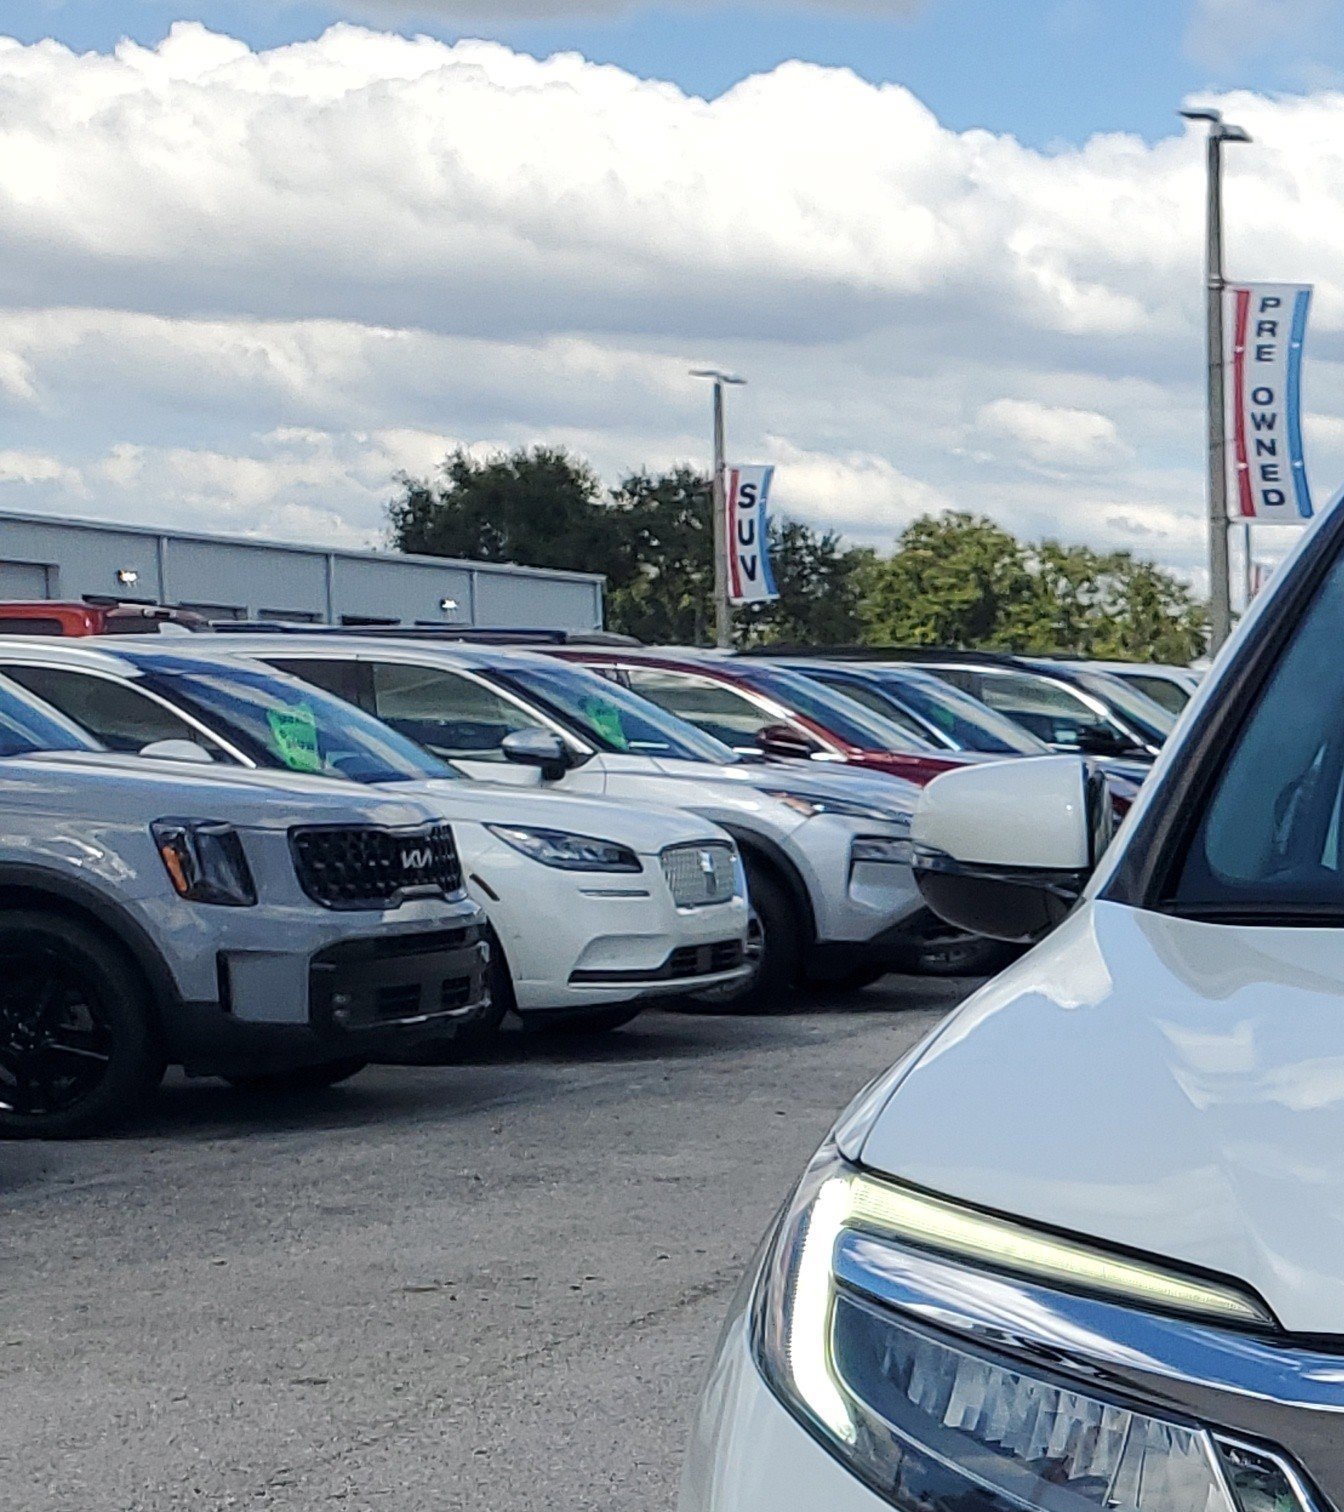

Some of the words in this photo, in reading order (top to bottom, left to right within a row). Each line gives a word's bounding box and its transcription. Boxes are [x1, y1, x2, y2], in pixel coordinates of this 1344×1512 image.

[1255, 296, 1281, 362] PRE
[1250, 386, 1286, 507] OWNED
[738, 483, 757, 582] SUV
